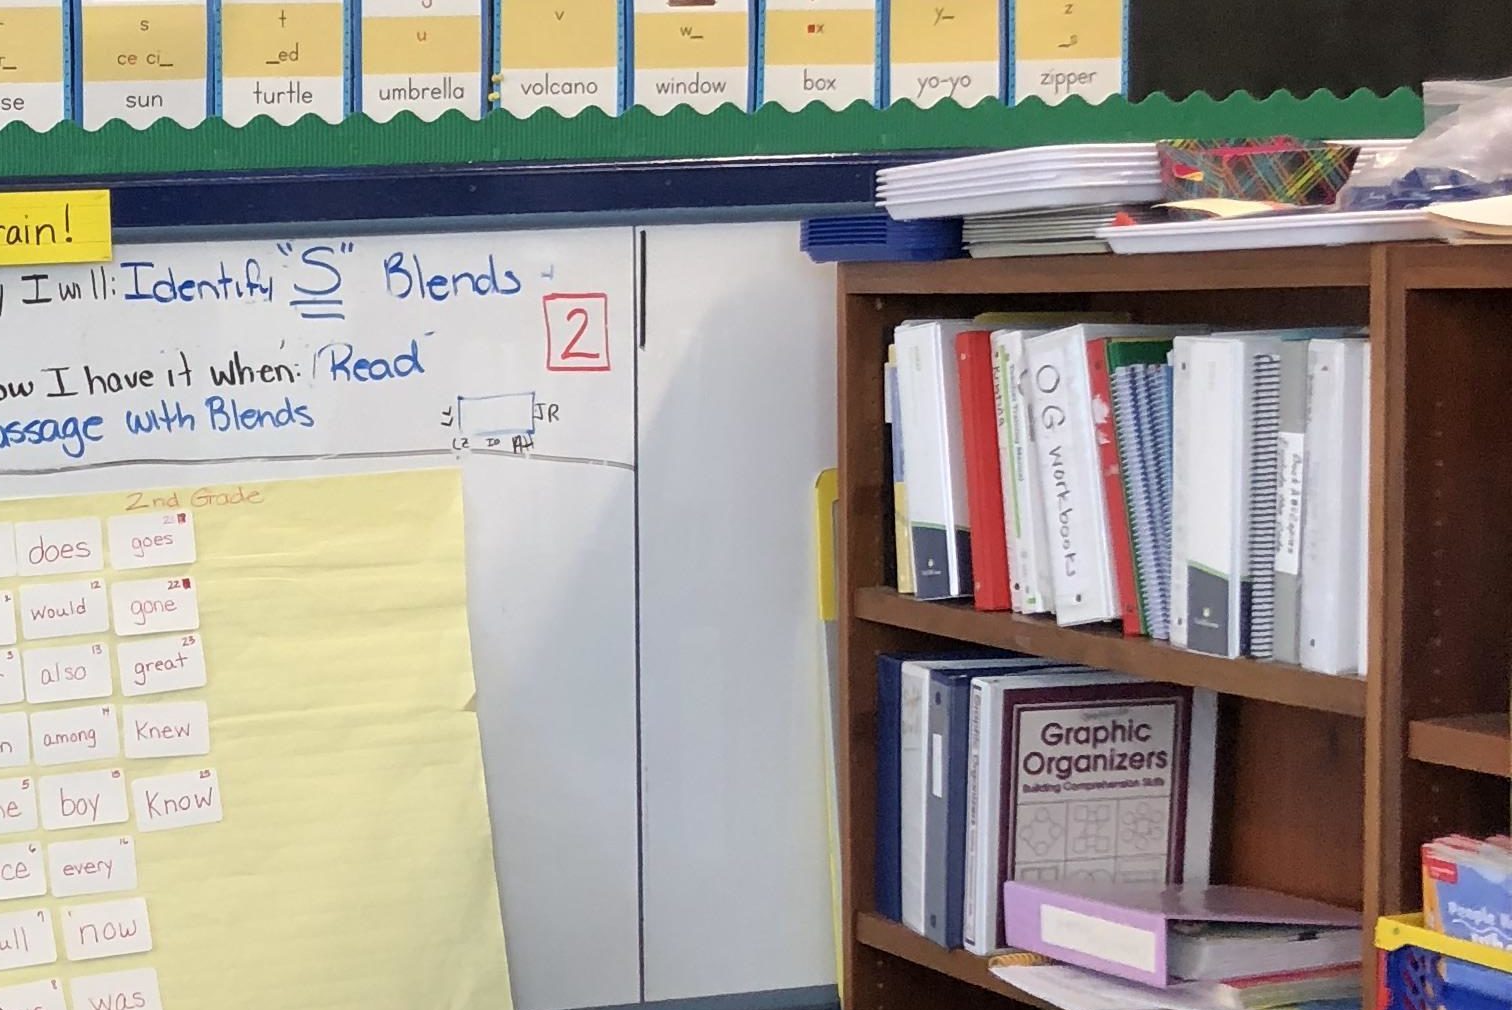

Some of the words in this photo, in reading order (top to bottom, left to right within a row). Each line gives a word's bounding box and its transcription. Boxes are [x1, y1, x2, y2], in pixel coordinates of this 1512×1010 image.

[253, 81, 314, 106] turtle
[378, 77, 465, 102] umbrella
[520, 73, 598, 97] volcano
[655, 72, 727, 96] window
[803, 69, 837, 92] box
[916, 75, 972, 99] yo-yo
[1039, 67, 1099, 95] zipper
[125, 93, 164, 109] sun
[20, 274, 52, 304] I
[120, 258, 274, 303] Identify
[383, 252, 522, 302] Blends
[560, 308, 601, 360] 2
[41, 366, 78, 398] I
[87, 365, 155, 395] have
[168, 350, 192, 389] it
[318, 339, 426, 383] Read
[126, 400, 196, 435] with
[205, 395, 316, 432] Blends
[126, 491, 182, 512] 2nd
[190, 487, 264, 508] Grade
[28, 535, 92, 566] does
[131, 532, 174, 558] goes
[31, 596, 87, 622] would
[130, 598, 178, 626] gone
[40, 662, 87, 686] also
[134, 651, 189, 686] great
[43, 727, 96, 749] among
[1040, 718, 1153, 749] Graphic
[1022, 747, 1169, 780] Organizers
[60, 787, 101, 822] boy
[62, 858, 114, 880] every
[79, 919, 138, 945] now
